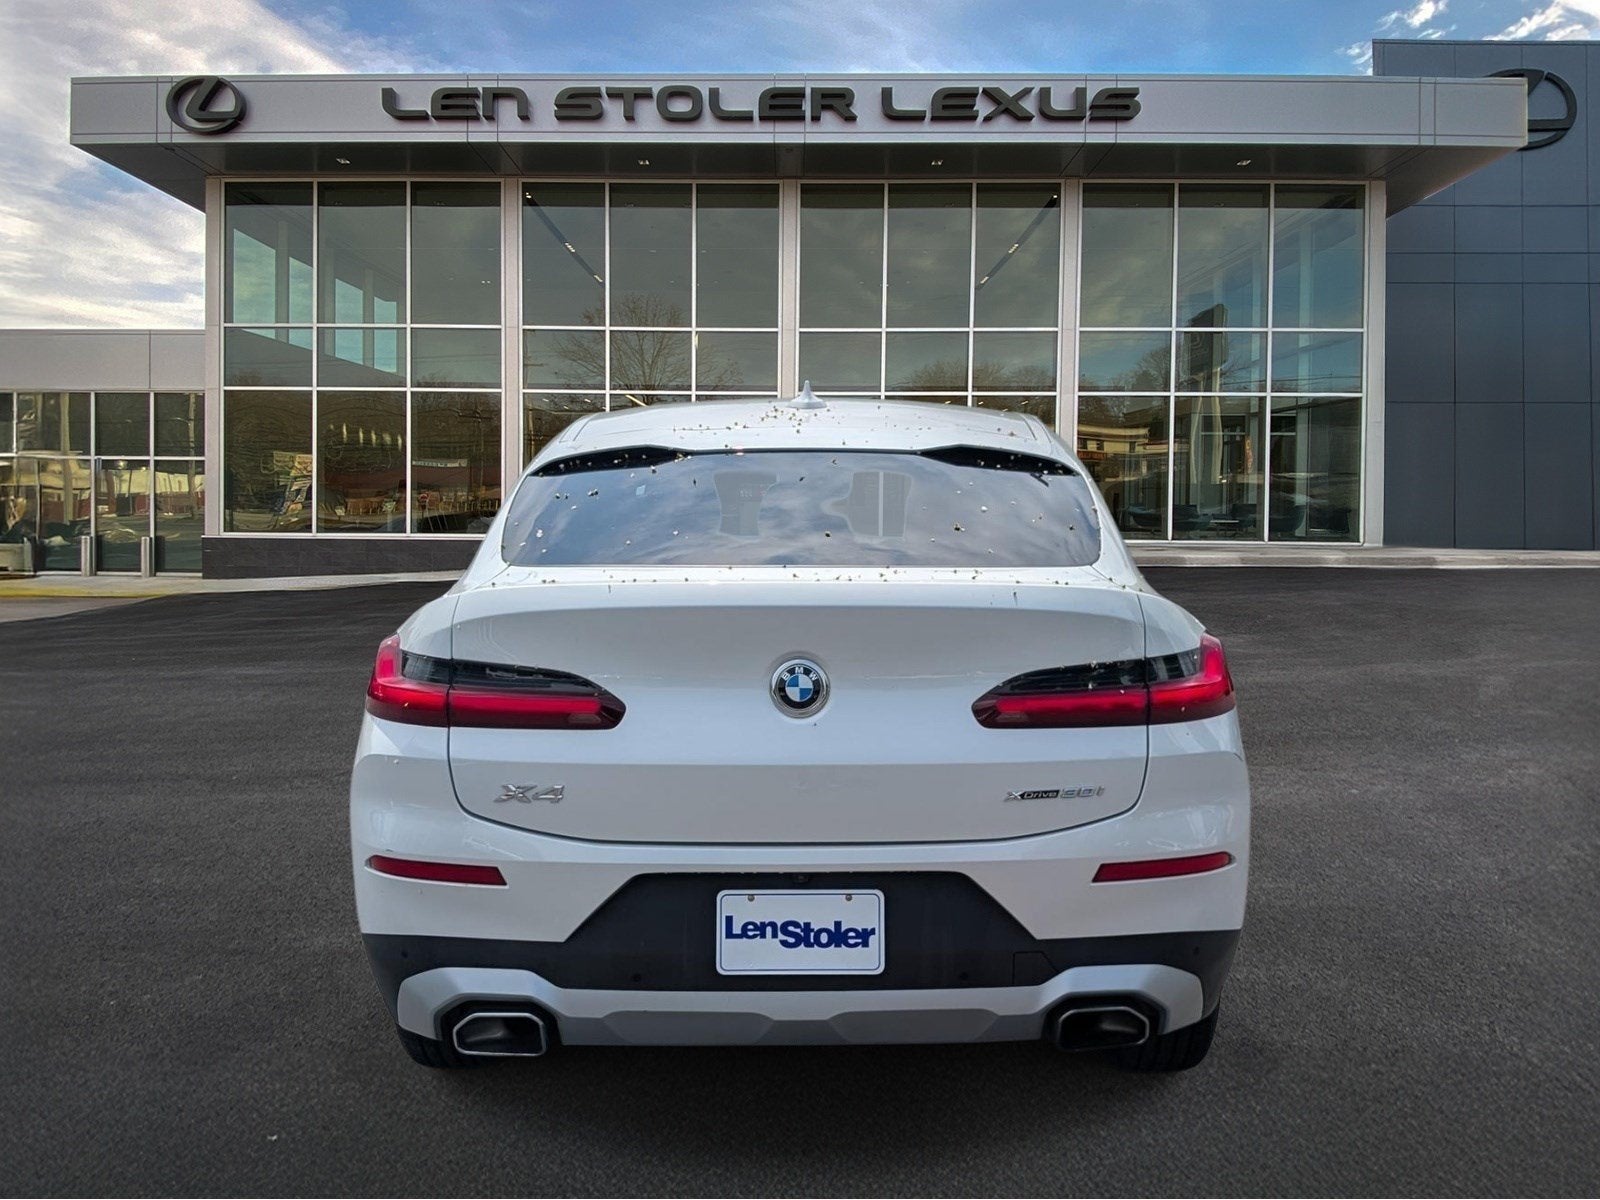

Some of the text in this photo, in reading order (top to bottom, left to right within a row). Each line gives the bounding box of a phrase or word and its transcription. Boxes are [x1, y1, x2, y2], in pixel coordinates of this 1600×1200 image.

[381, 86, 1142, 121] LEN STOLER LEXUS
[781, 666, 819, 681] BMW
[493, 784, 565, 803] X4
